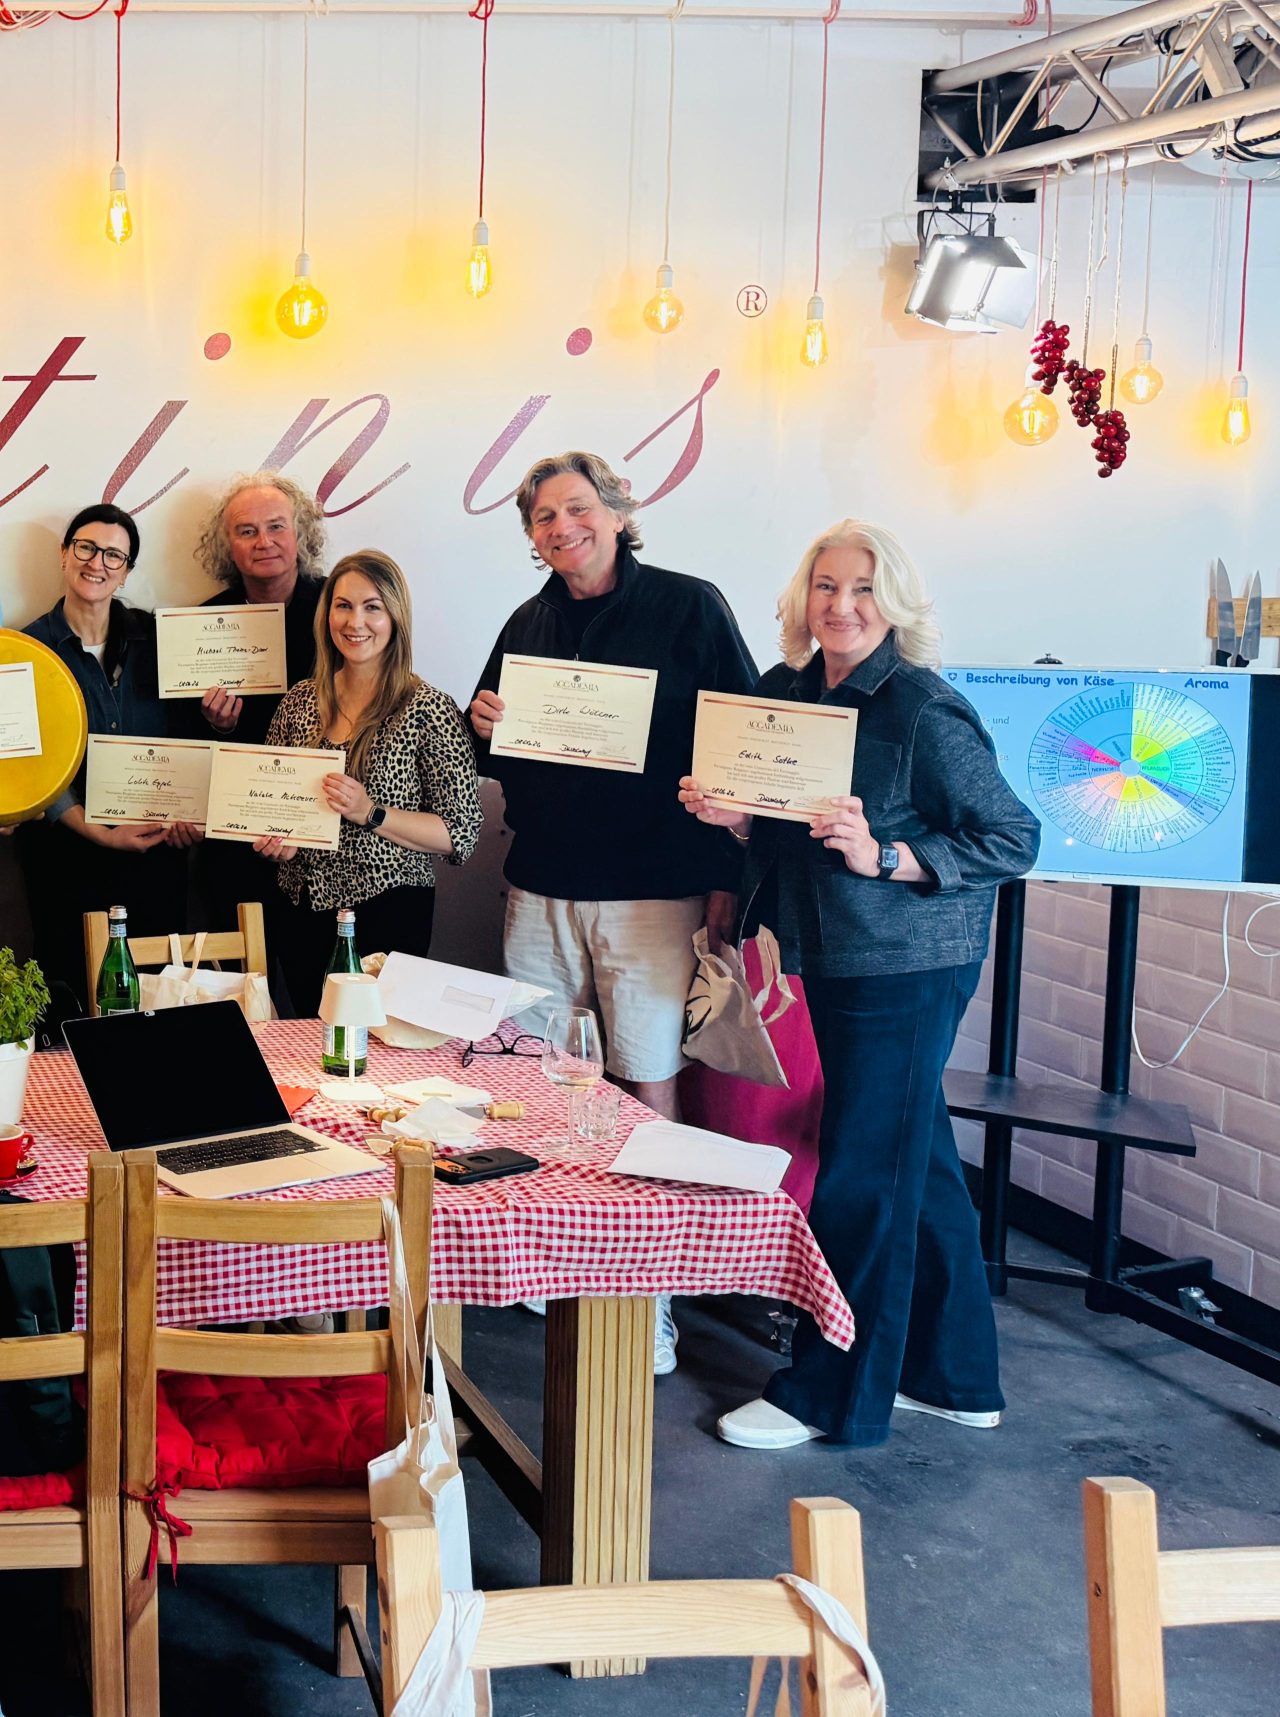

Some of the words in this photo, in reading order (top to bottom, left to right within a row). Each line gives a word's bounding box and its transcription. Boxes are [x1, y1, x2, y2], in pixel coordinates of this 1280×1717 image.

[966, 672, 1051, 687] Beschreibung
[1057, 677, 1078, 686] von
[1084, 675, 1115, 686] Käse
[1184, 678, 1229, 689] Aroma
